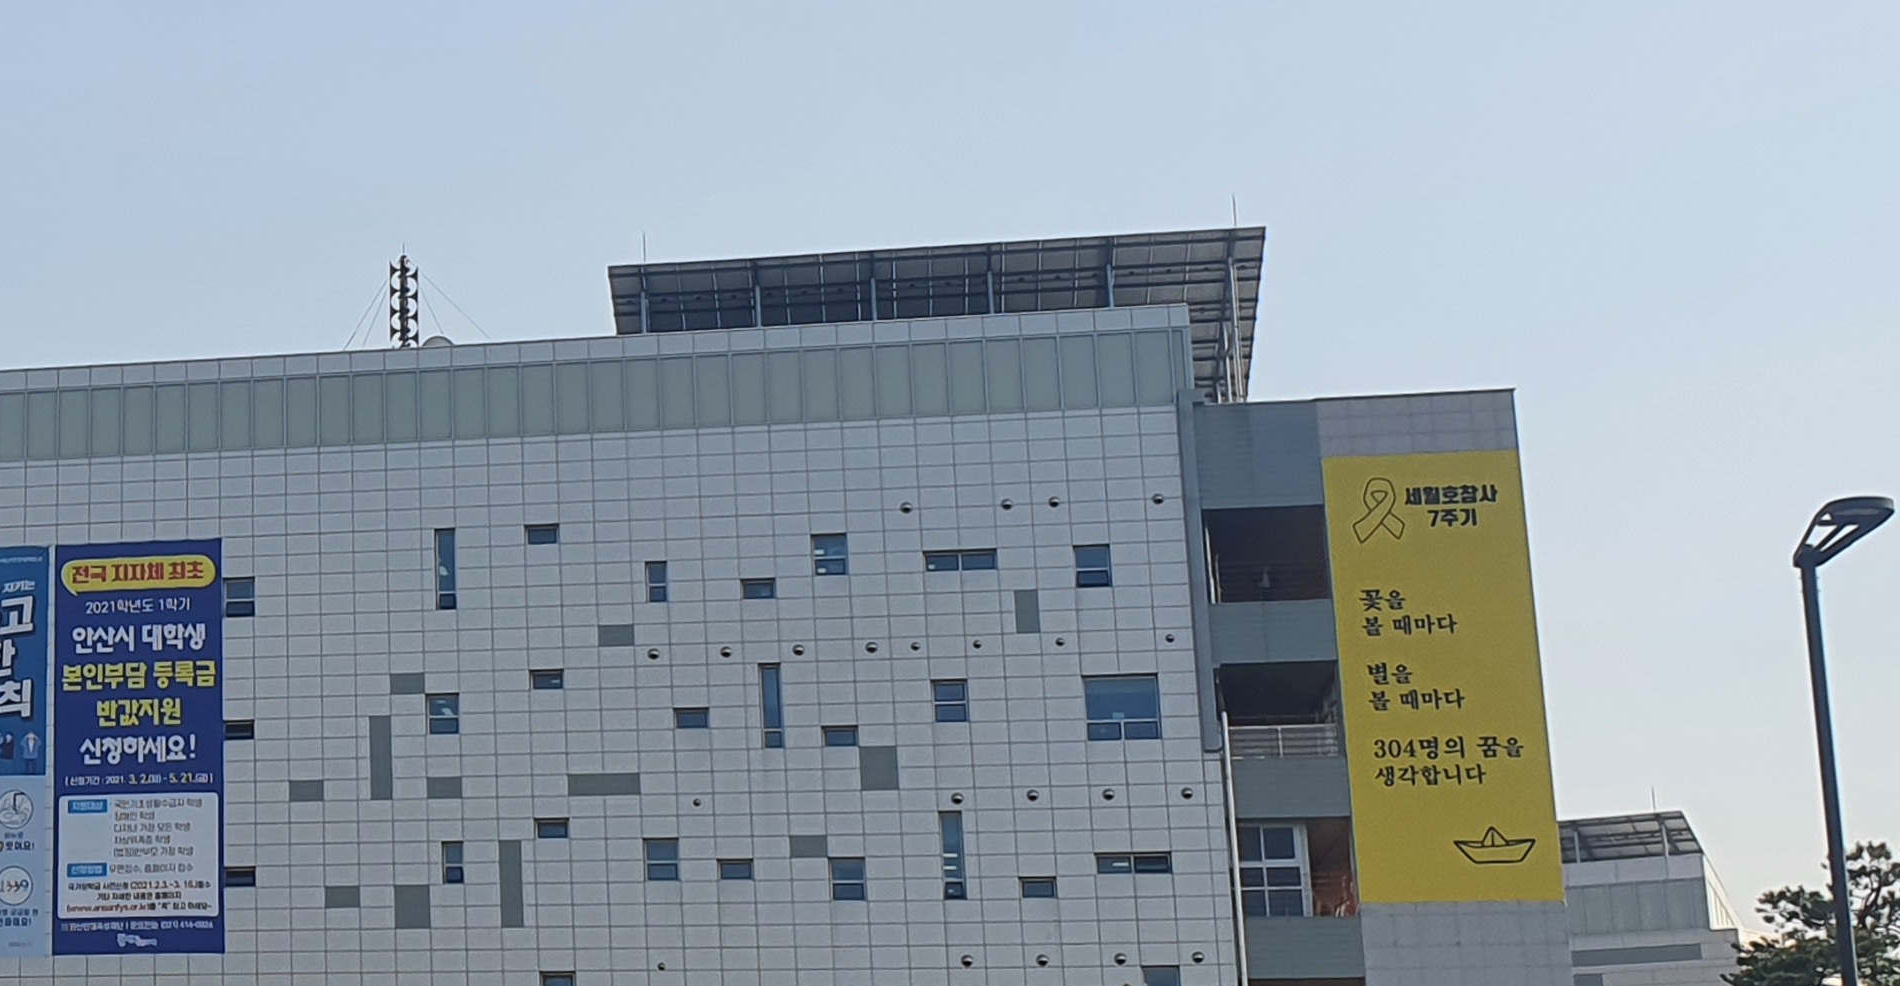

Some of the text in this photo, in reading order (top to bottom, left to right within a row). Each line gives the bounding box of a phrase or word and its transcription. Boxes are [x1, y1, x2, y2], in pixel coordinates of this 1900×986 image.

[1404, 484, 1498, 505] 세월호참사
[1427, 508, 1478, 527] 7주기
[72, 561, 204, 584] 전국 지자체 최초
[2, 580, 36, 594] 지키는
[85, 597, 190, 614] 2021학년도 1학기
[1359, 589, 1406, 611] 꽃을
[1362, 614, 1458, 636] 볼 때마다
[72, 623, 206, 654] 안산시 대학생
[62, 660, 216, 691] 본인부담 등록금
[1367, 662, 1413, 685] 별을
[1369, 688, 1466, 711] 볼 때마다
[96, 697, 181, 727] 반값지원
[79, 734, 196, 765] 신청하세요!
[1373, 736, 1525, 760] 304명의 꿈을
[1375, 763, 1487, 787] 생각합니다
